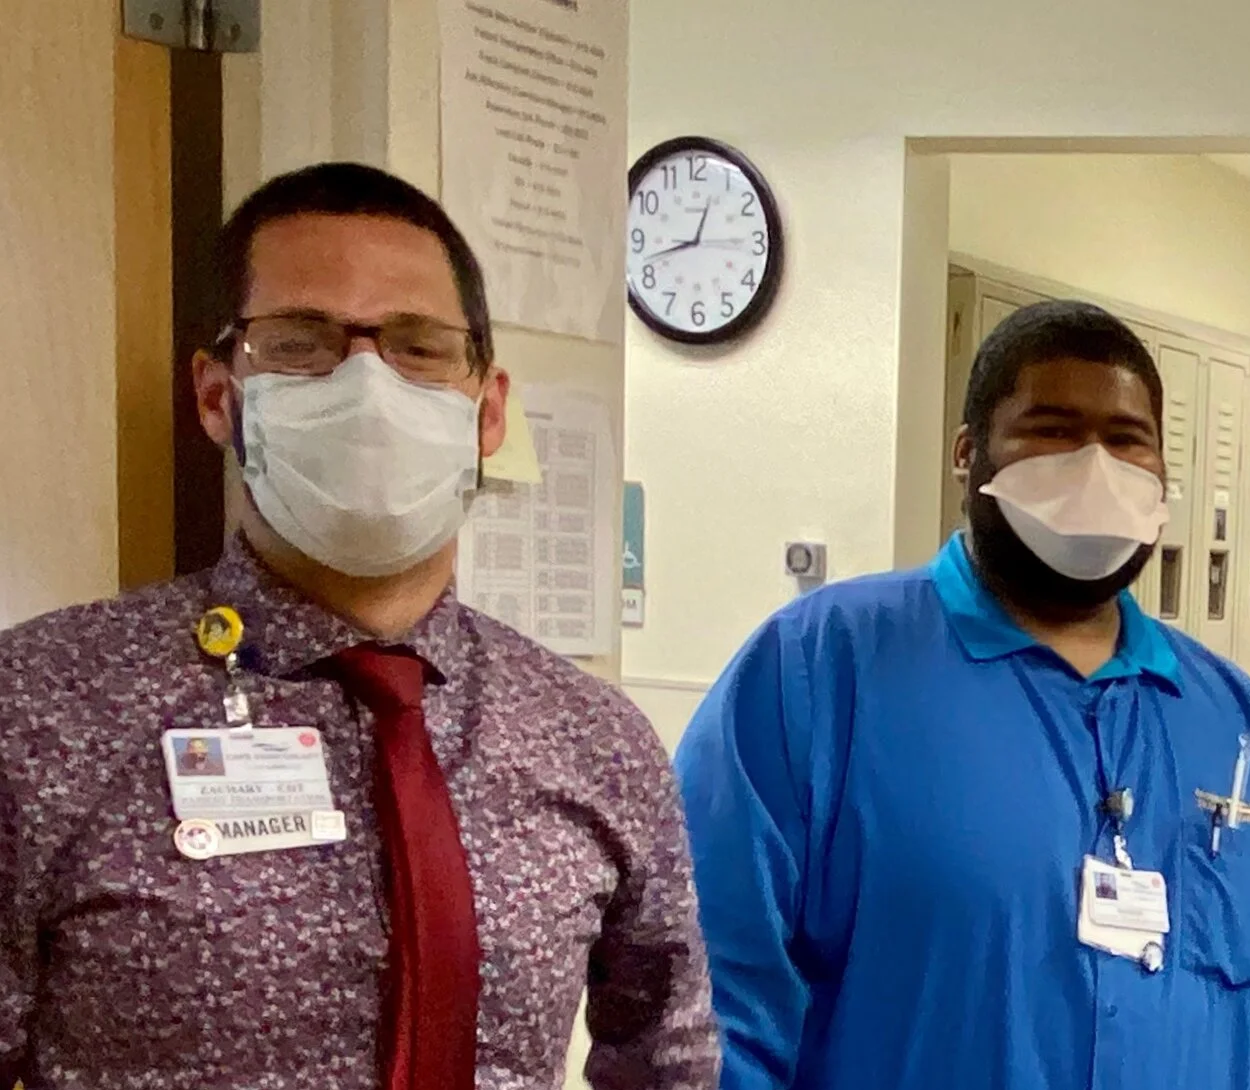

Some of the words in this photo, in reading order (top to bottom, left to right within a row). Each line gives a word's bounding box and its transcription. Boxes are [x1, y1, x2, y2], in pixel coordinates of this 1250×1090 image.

[661, 166, 677, 191] 11
[686, 156, 707, 182] 12
[723, 167, 731, 192] 1
[638, 190, 659, 216] 10
[740, 191, 755, 217] 2
[631, 227, 645, 254] 9
[751, 230, 766, 257] 3
[642, 263, 656, 290] 8
[740, 268, 756, 293] 4
[662, 291, 677, 317] 7
[691, 300, 706, 327] 6
[720, 291, 734, 319] 5
[214, 814, 307, 840] MANAGER
